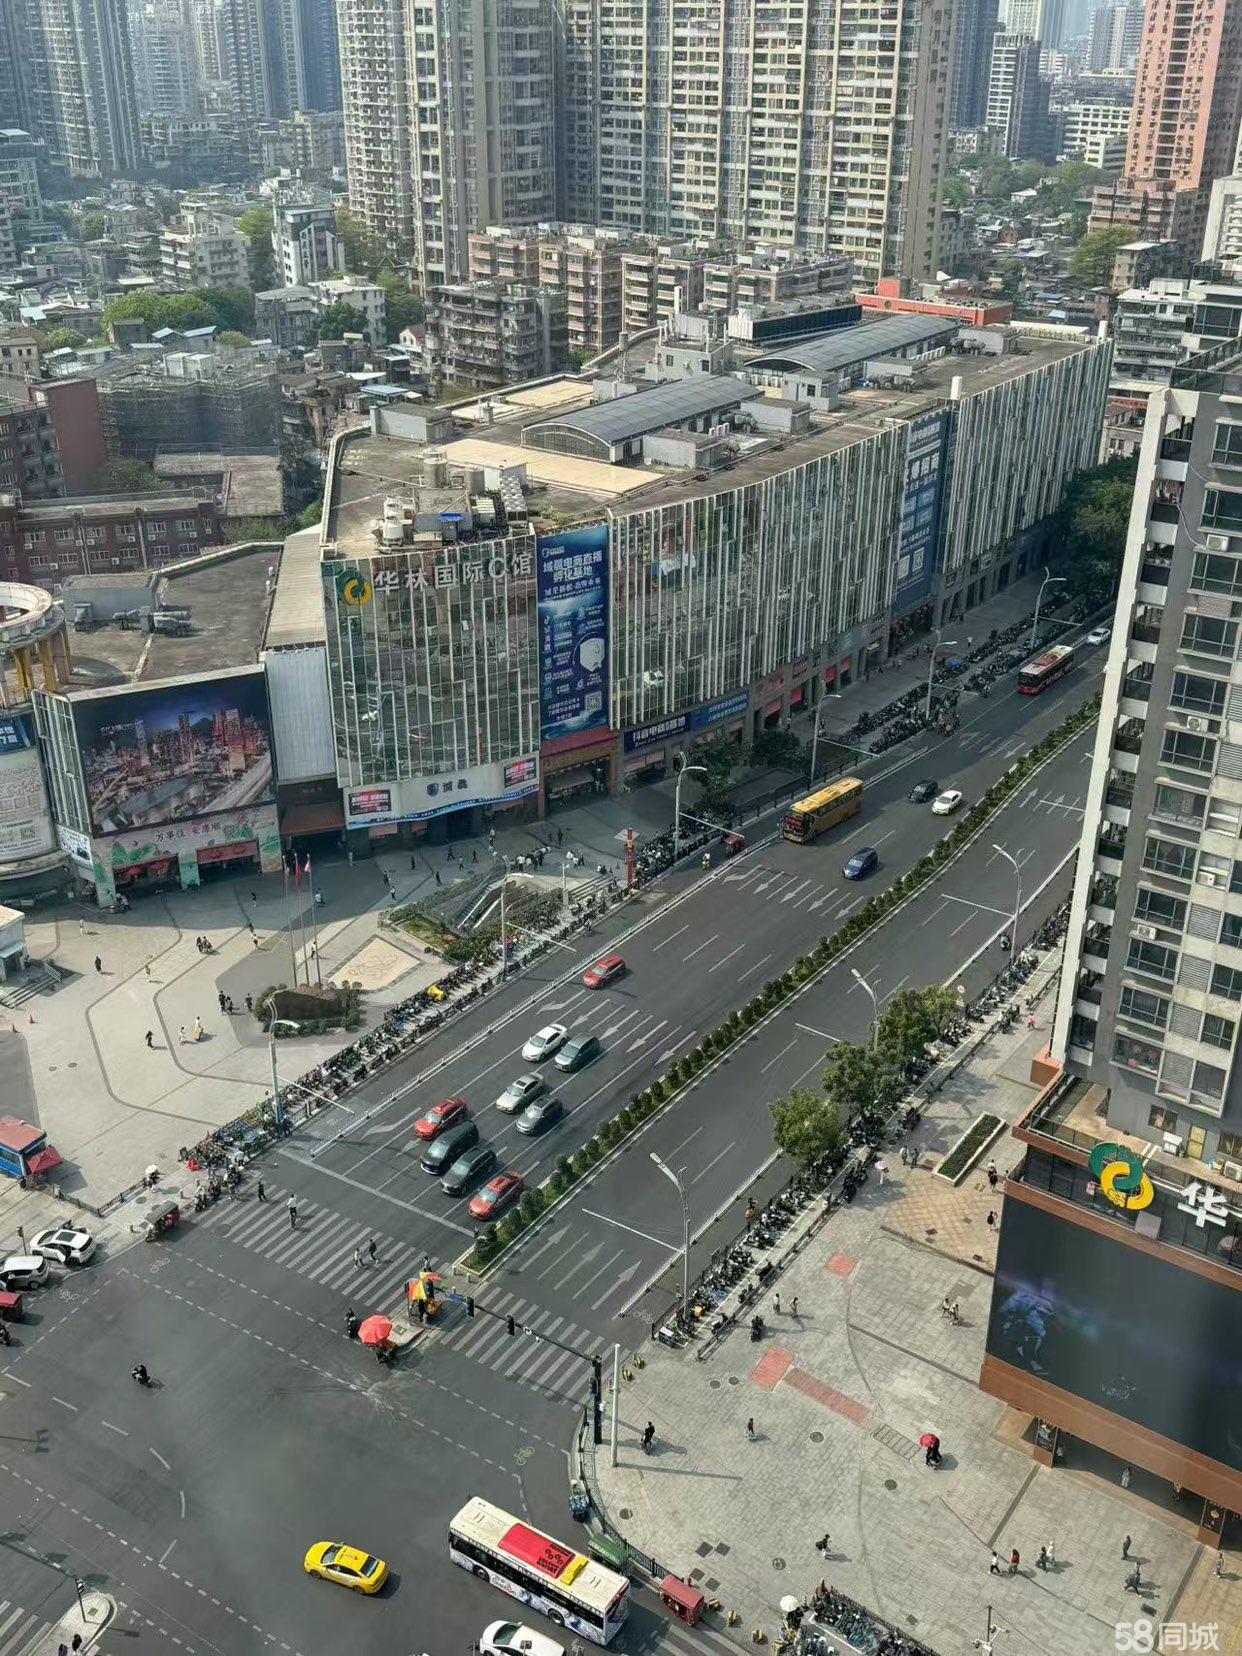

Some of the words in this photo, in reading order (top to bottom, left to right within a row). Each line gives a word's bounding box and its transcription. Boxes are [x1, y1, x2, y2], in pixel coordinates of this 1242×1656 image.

[374, 551, 533, 595] 华林国际C馆
[1177, 1182, 1229, 1228] 华
